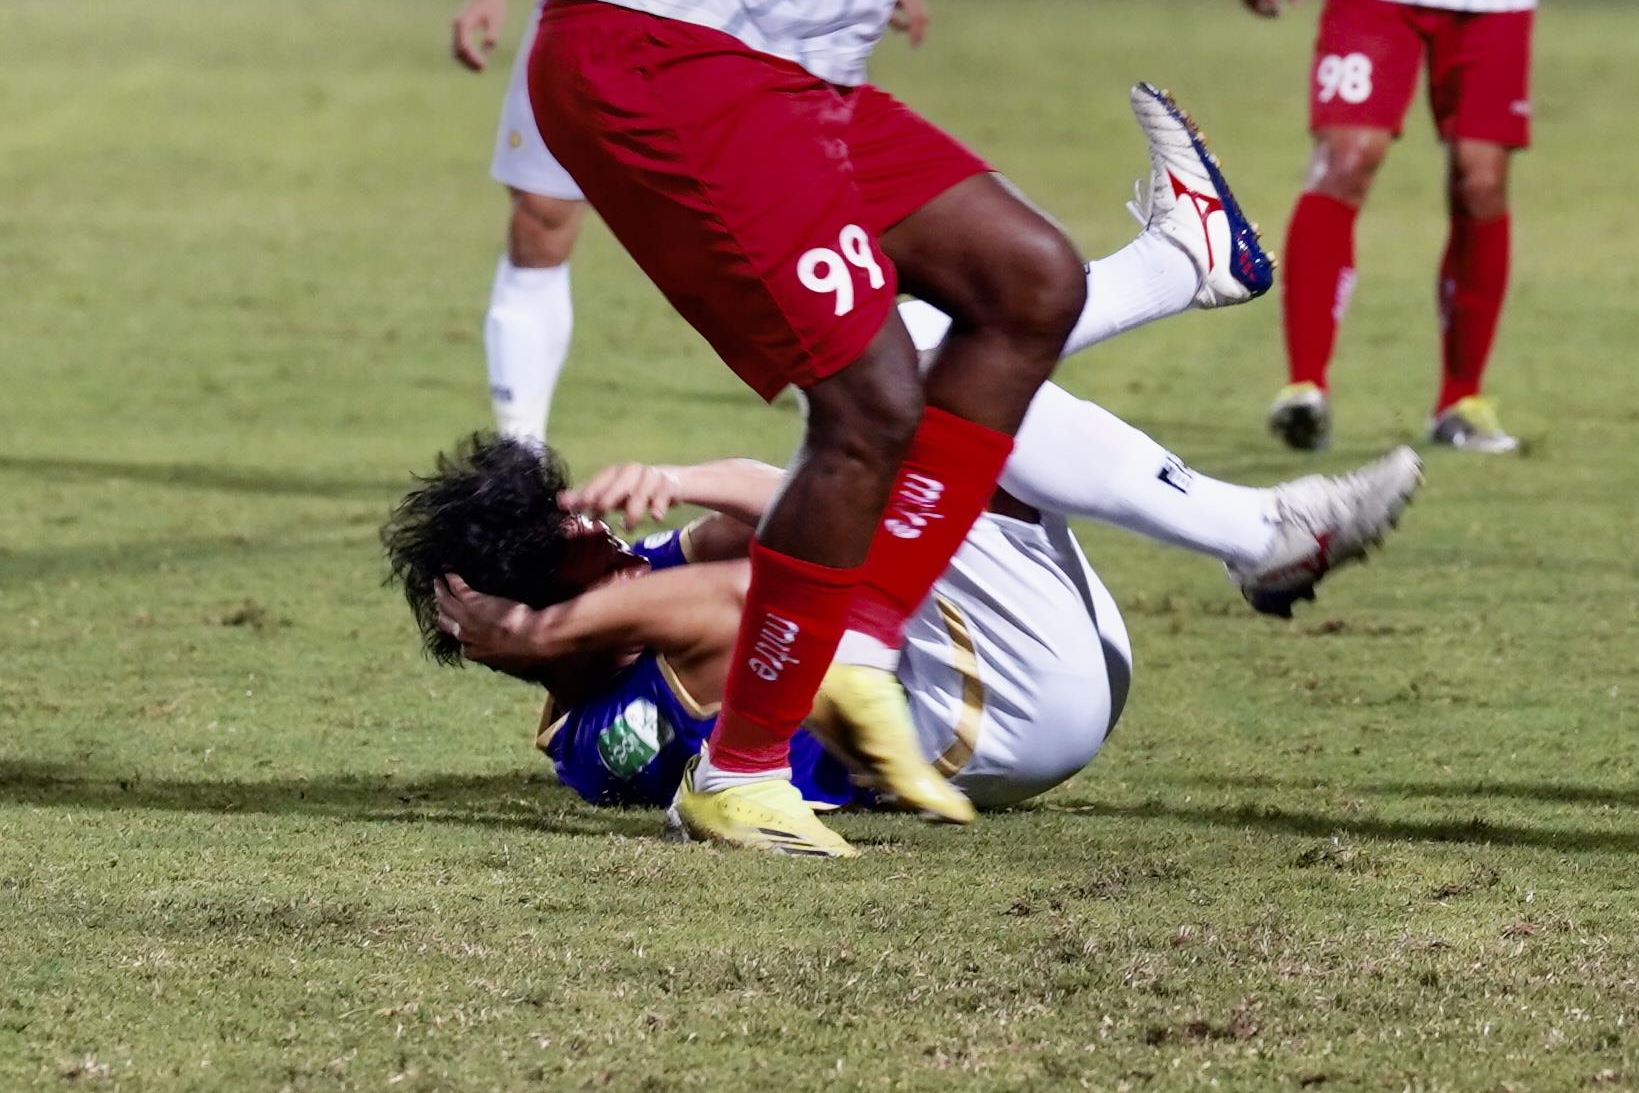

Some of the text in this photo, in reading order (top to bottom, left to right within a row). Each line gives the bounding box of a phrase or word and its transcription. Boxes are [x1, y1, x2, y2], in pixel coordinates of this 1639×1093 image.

[1317, 52, 1373, 104] 98
[796, 223, 886, 317] 99
[884, 473, 944, 539] mitre
[748, 612, 800, 681] mitre
